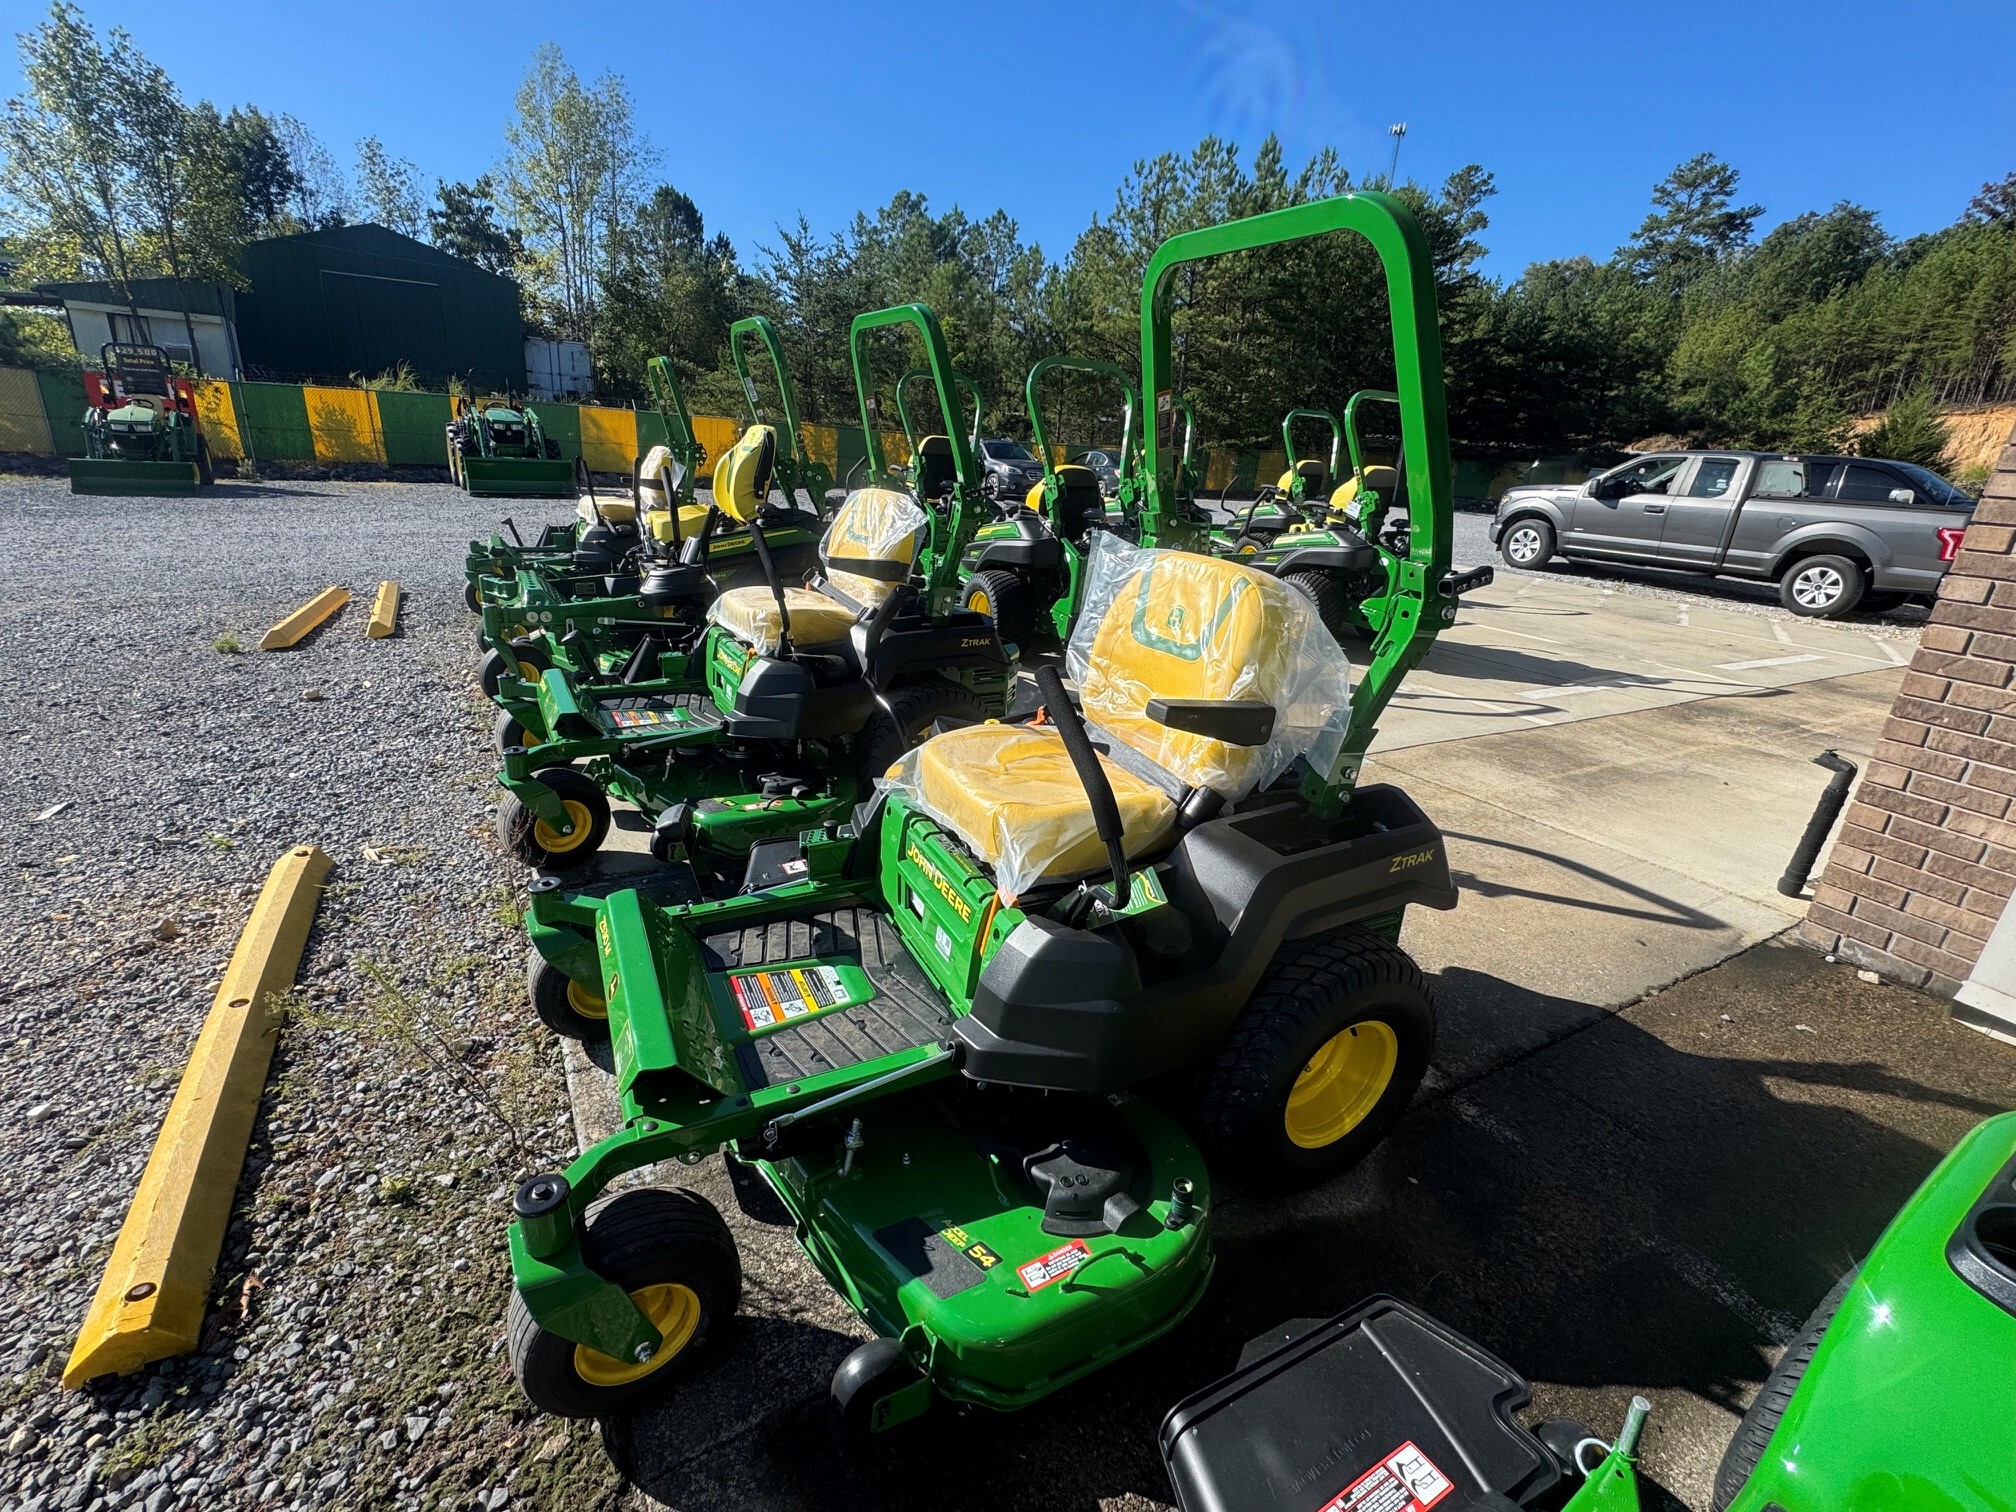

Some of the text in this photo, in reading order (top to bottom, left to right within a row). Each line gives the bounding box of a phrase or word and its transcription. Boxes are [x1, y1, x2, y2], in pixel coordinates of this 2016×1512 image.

[123, 357, 155, 366] Total Price
[712, 541, 728, 550] JOHN
[961, 638, 991, 648] ZTRAK
[1389, 848, 1434, 873] ZTRAK
[907, 842, 932, 881] JOHN
[933, 868, 972, 925] DEERE
[941, 1219, 969, 1242] ACCEL
[941, 1228, 966, 1248] DEEP
[968, 1244, 997, 1267] 54
[1052, 1244, 1073, 1257] DANGER
